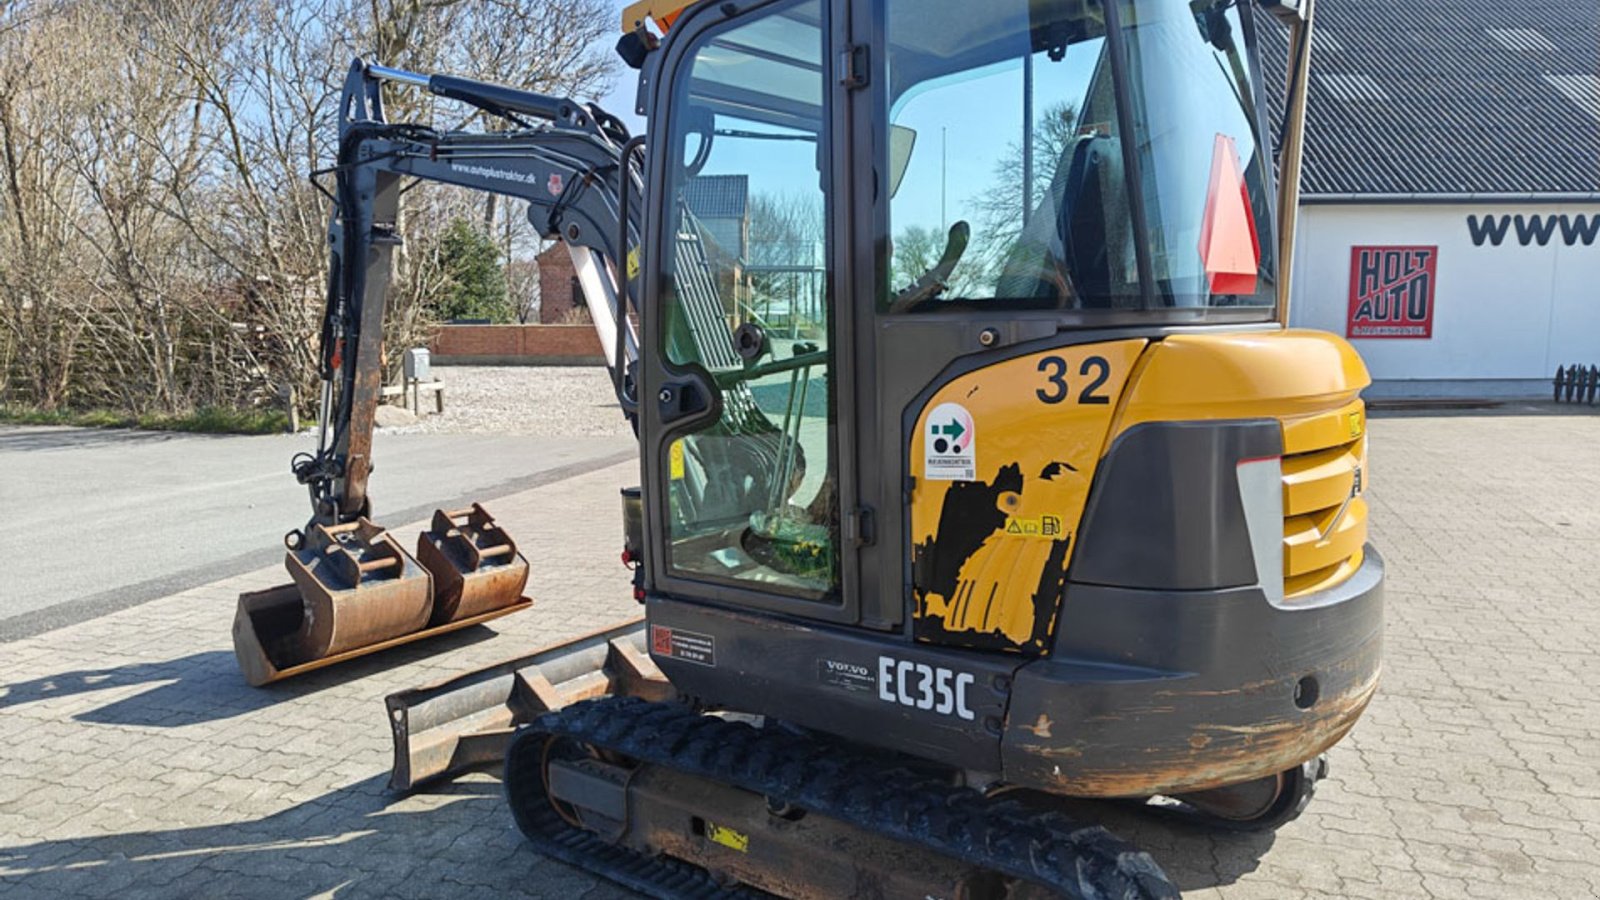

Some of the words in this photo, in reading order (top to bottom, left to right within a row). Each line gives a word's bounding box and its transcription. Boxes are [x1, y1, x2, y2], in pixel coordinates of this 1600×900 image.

[1353, 272, 1429, 321] AUTO
[1359, 250, 1430, 299] HOLT
[1036, 356, 1111, 404] 32
[826, 660, 869, 676] VOLVO
[879, 656, 975, 720] EC35C
